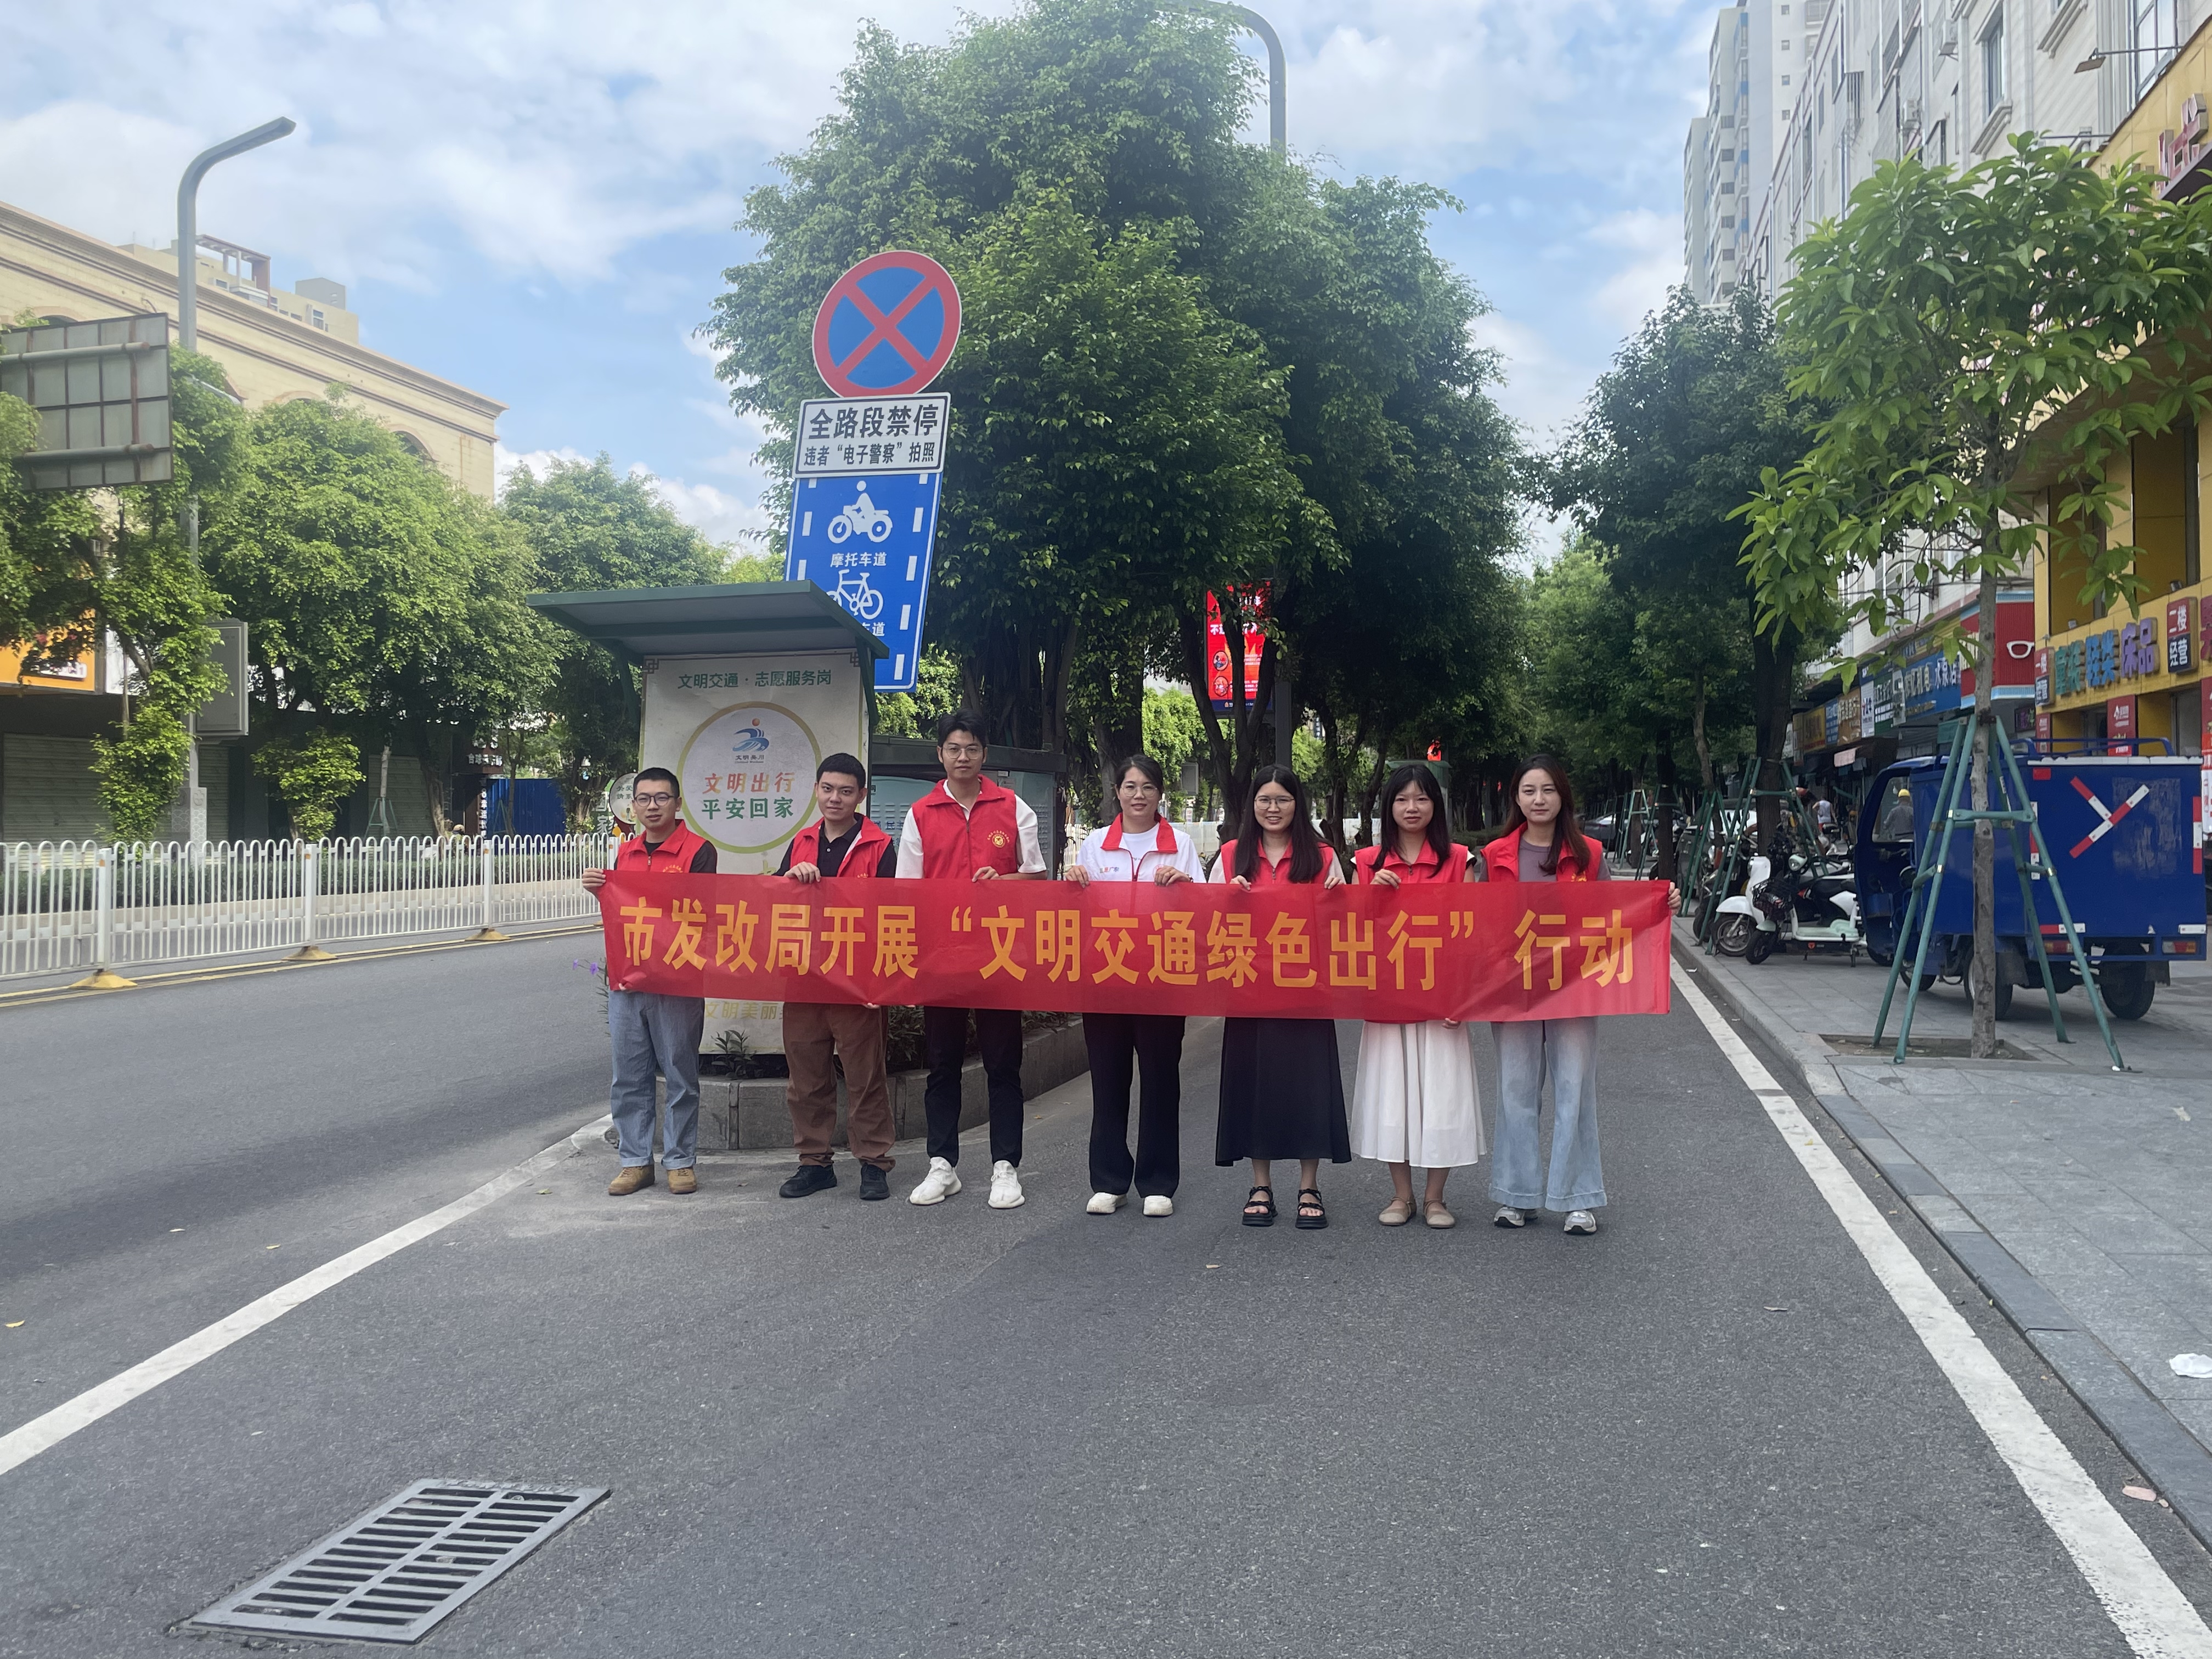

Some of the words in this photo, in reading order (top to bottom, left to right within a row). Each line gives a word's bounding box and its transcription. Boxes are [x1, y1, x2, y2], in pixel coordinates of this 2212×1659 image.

[809, 403, 938, 439] 全路段禁停
[804, 447, 830, 466] 违者
[909, 442, 935, 463] 拍照
[830, 551, 887, 568] 摩托车道
[2169, 604, 2187, 633] 二楼
[2169, 639, 2188, 667] 经营
[702, 772, 795, 794] 文明出行
[702, 796, 794, 820] 平安回家
[619, 896, 919, 980] 市发改局开展
[1514, 909, 1633, 990] 行动
[705, 1001, 783, 1020] 文明美丽
